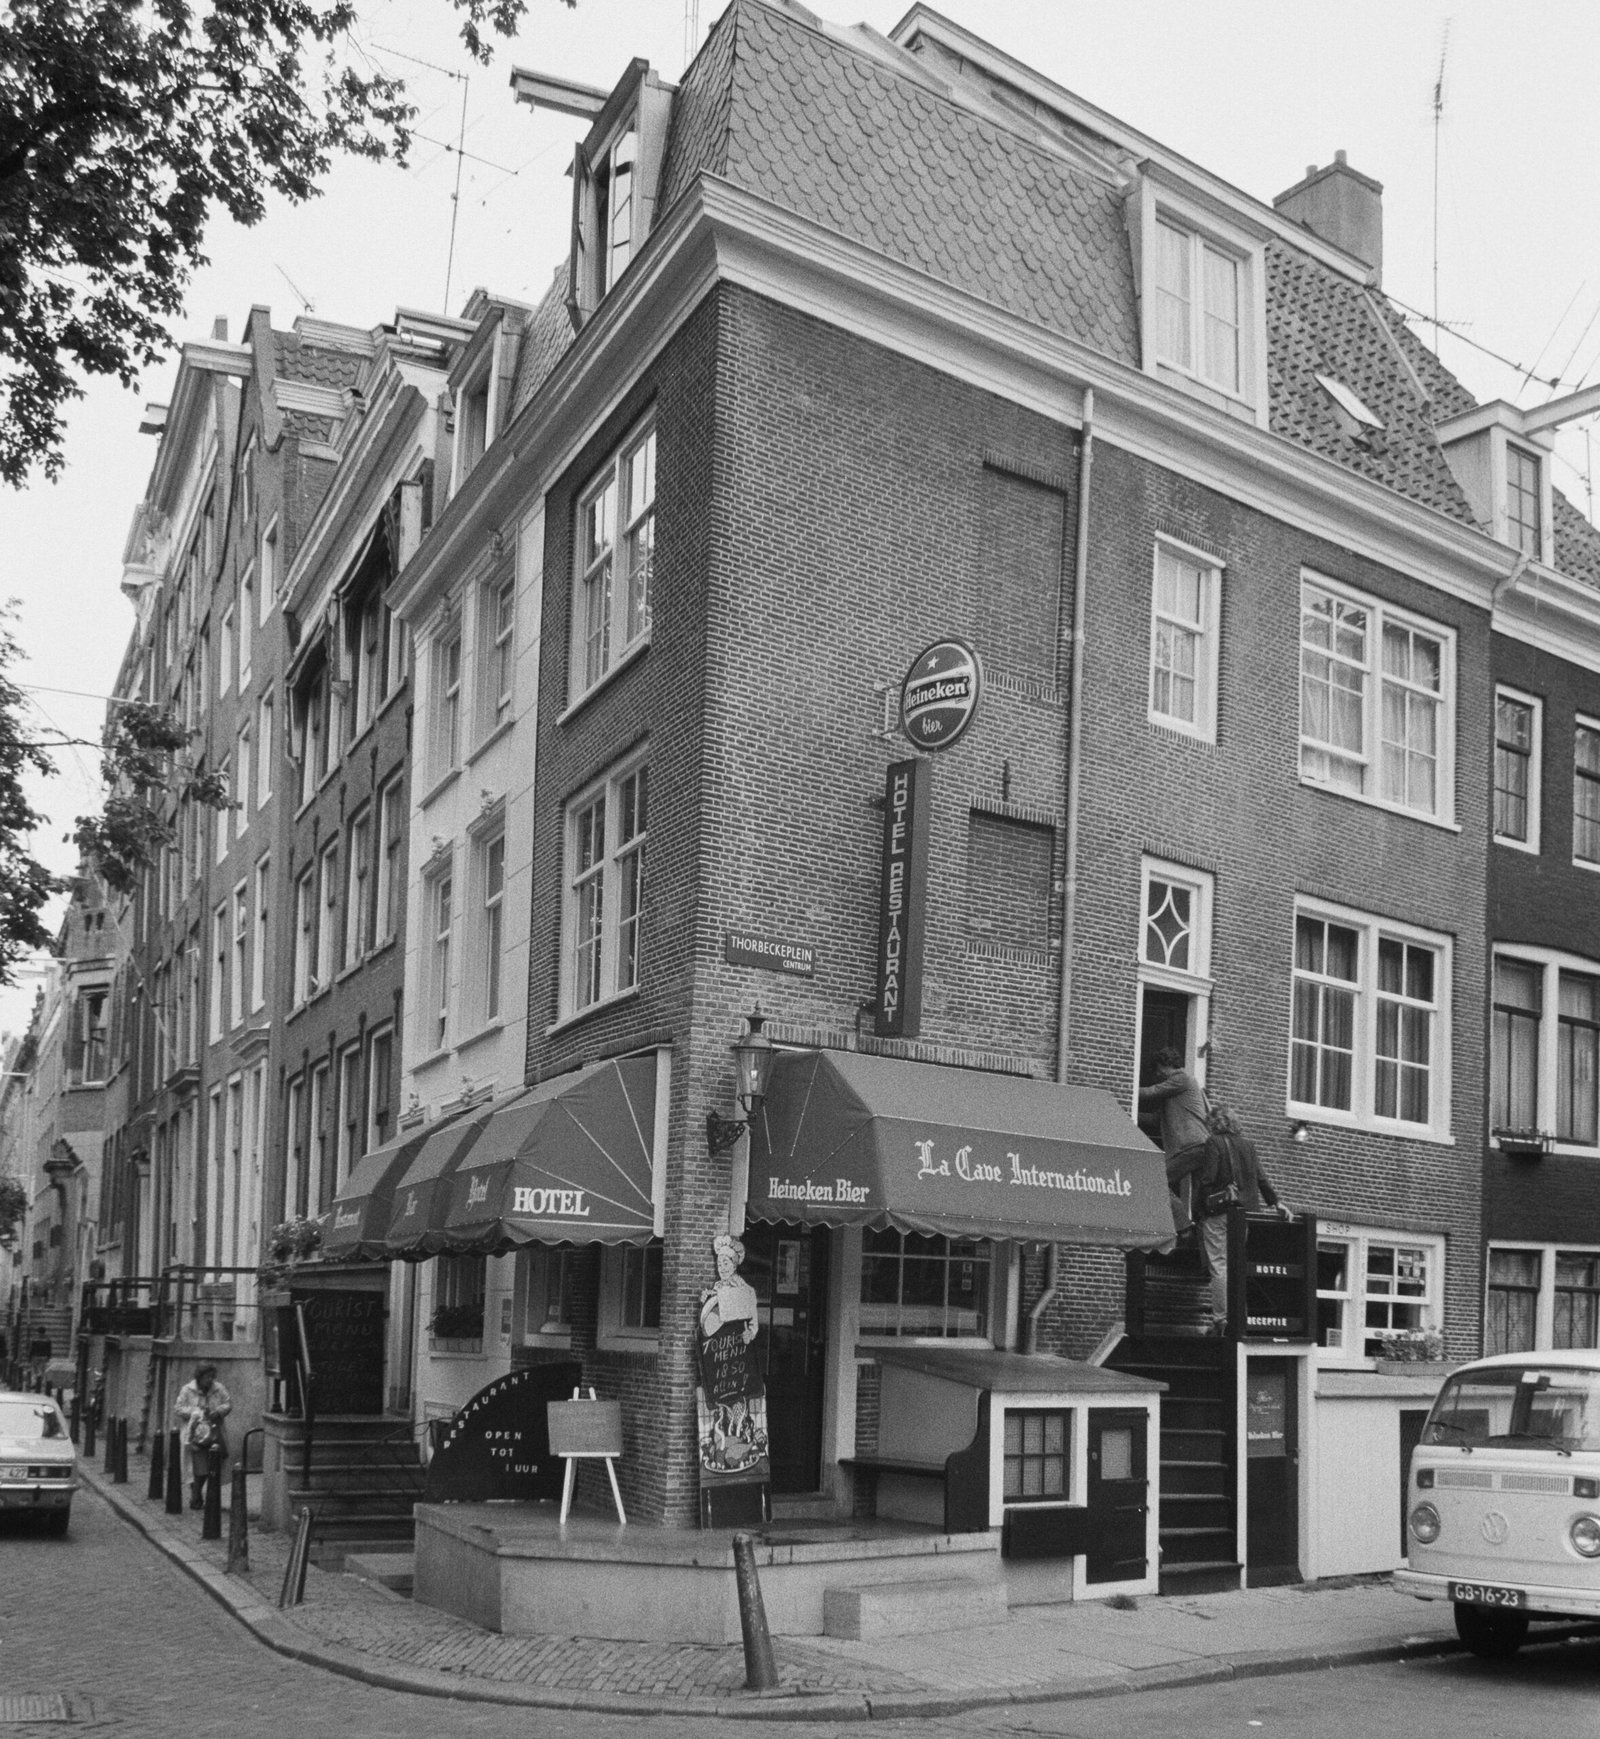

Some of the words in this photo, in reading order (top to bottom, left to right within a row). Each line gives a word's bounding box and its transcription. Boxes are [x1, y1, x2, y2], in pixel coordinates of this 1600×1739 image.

[904, 677, 968, 708] Heineken
[922, 716, 944, 735] bier
[891, 774, 909, 855] HOTEL
[731, 934, 813, 963] THORBECKEPLEIN
[883, 862, 904, 1022] RESTAURANT
[782, 958, 812, 973] CENTRUM
[914, 1138, 952, 1181] La
[954, 1144, 1003, 1183] Cave
[1006, 1151, 1133, 1197] Internationale
[512, 1186, 590, 1217] HOTEL
[768, 1176, 834, 1202] Heineken
[834, 1178, 871, 1204] Bier
[1256, 1264, 1288, 1276] HOTEL
[1247, 1316, 1288, 1327] RECEPTIE
[713, 1344, 747, 1363] MENU
[443, 1372, 530, 1450] RESTAURANT
[485, 1430, 522, 1440] OPEN
[490, 1447, 513, 1457] TOT
[514, 1464, 538, 1474] UUR
